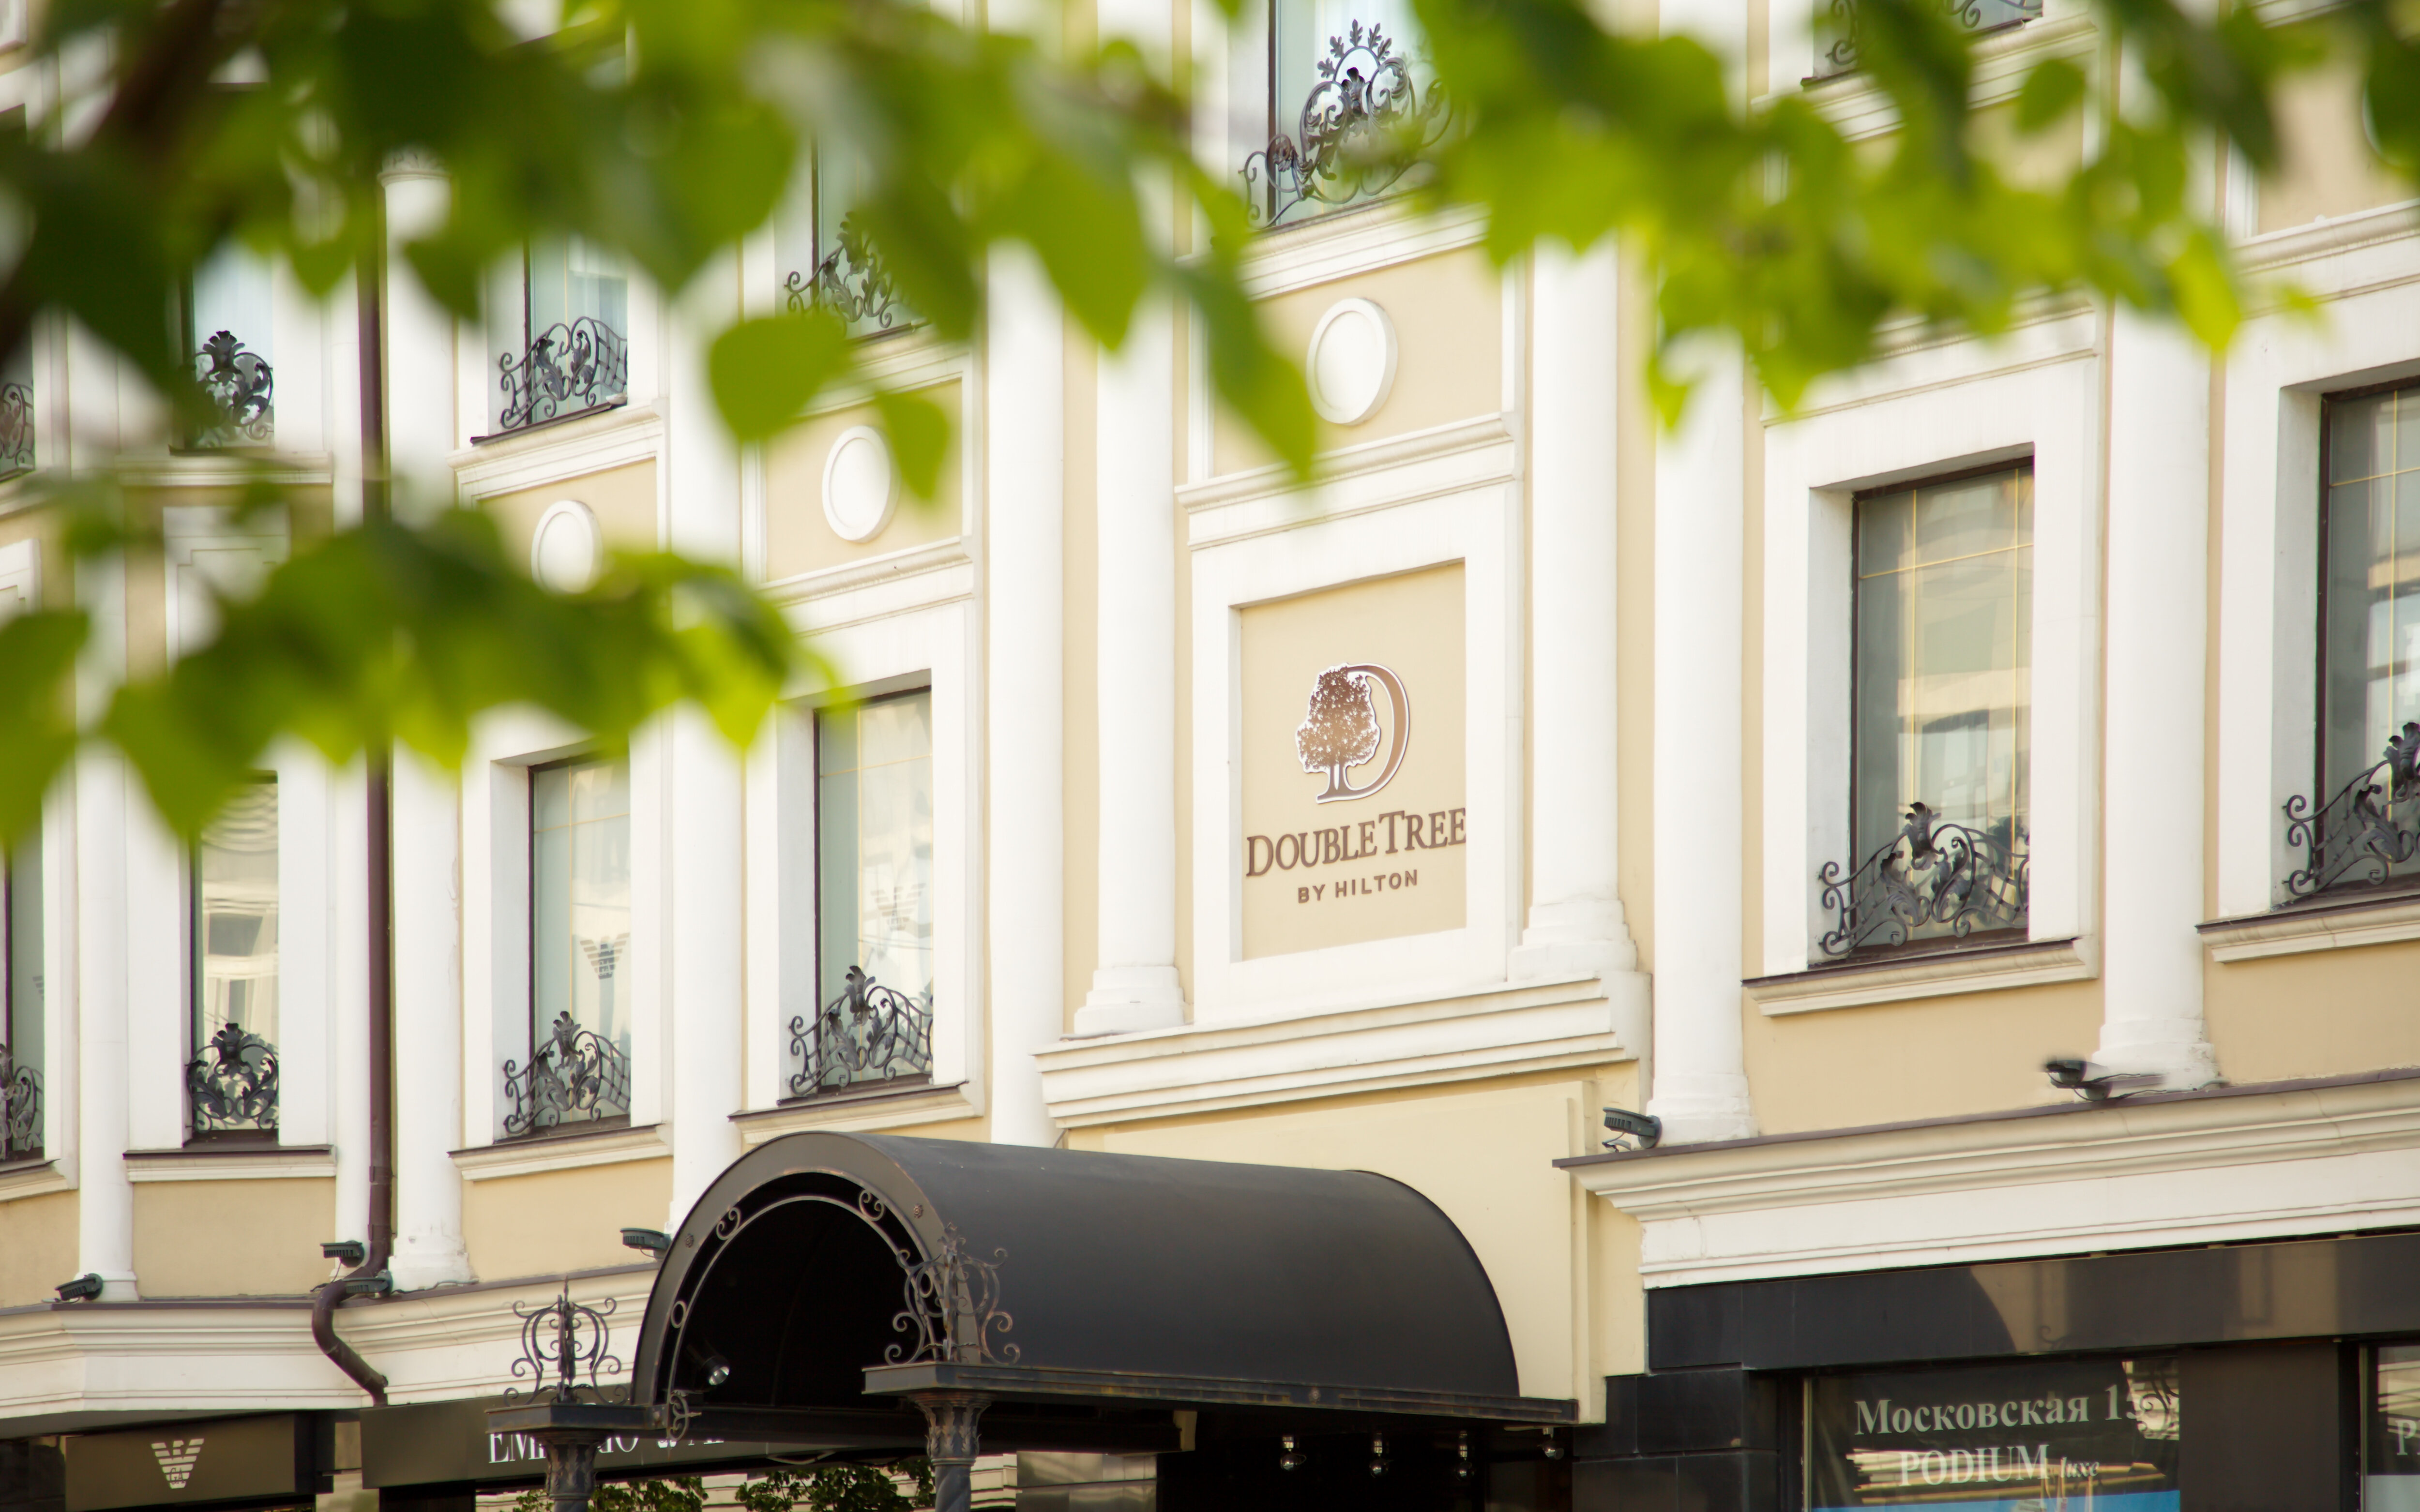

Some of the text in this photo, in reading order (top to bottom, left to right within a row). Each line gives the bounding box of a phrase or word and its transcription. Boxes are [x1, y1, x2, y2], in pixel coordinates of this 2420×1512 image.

[1298, 869, 1418, 904] BY HILTON
[1854, 1382, 2146, 1435] Московская 15
[2395, 1420, 2420, 1455] P
[1899, 1444, 2100, 1487] PODIUM luxe
